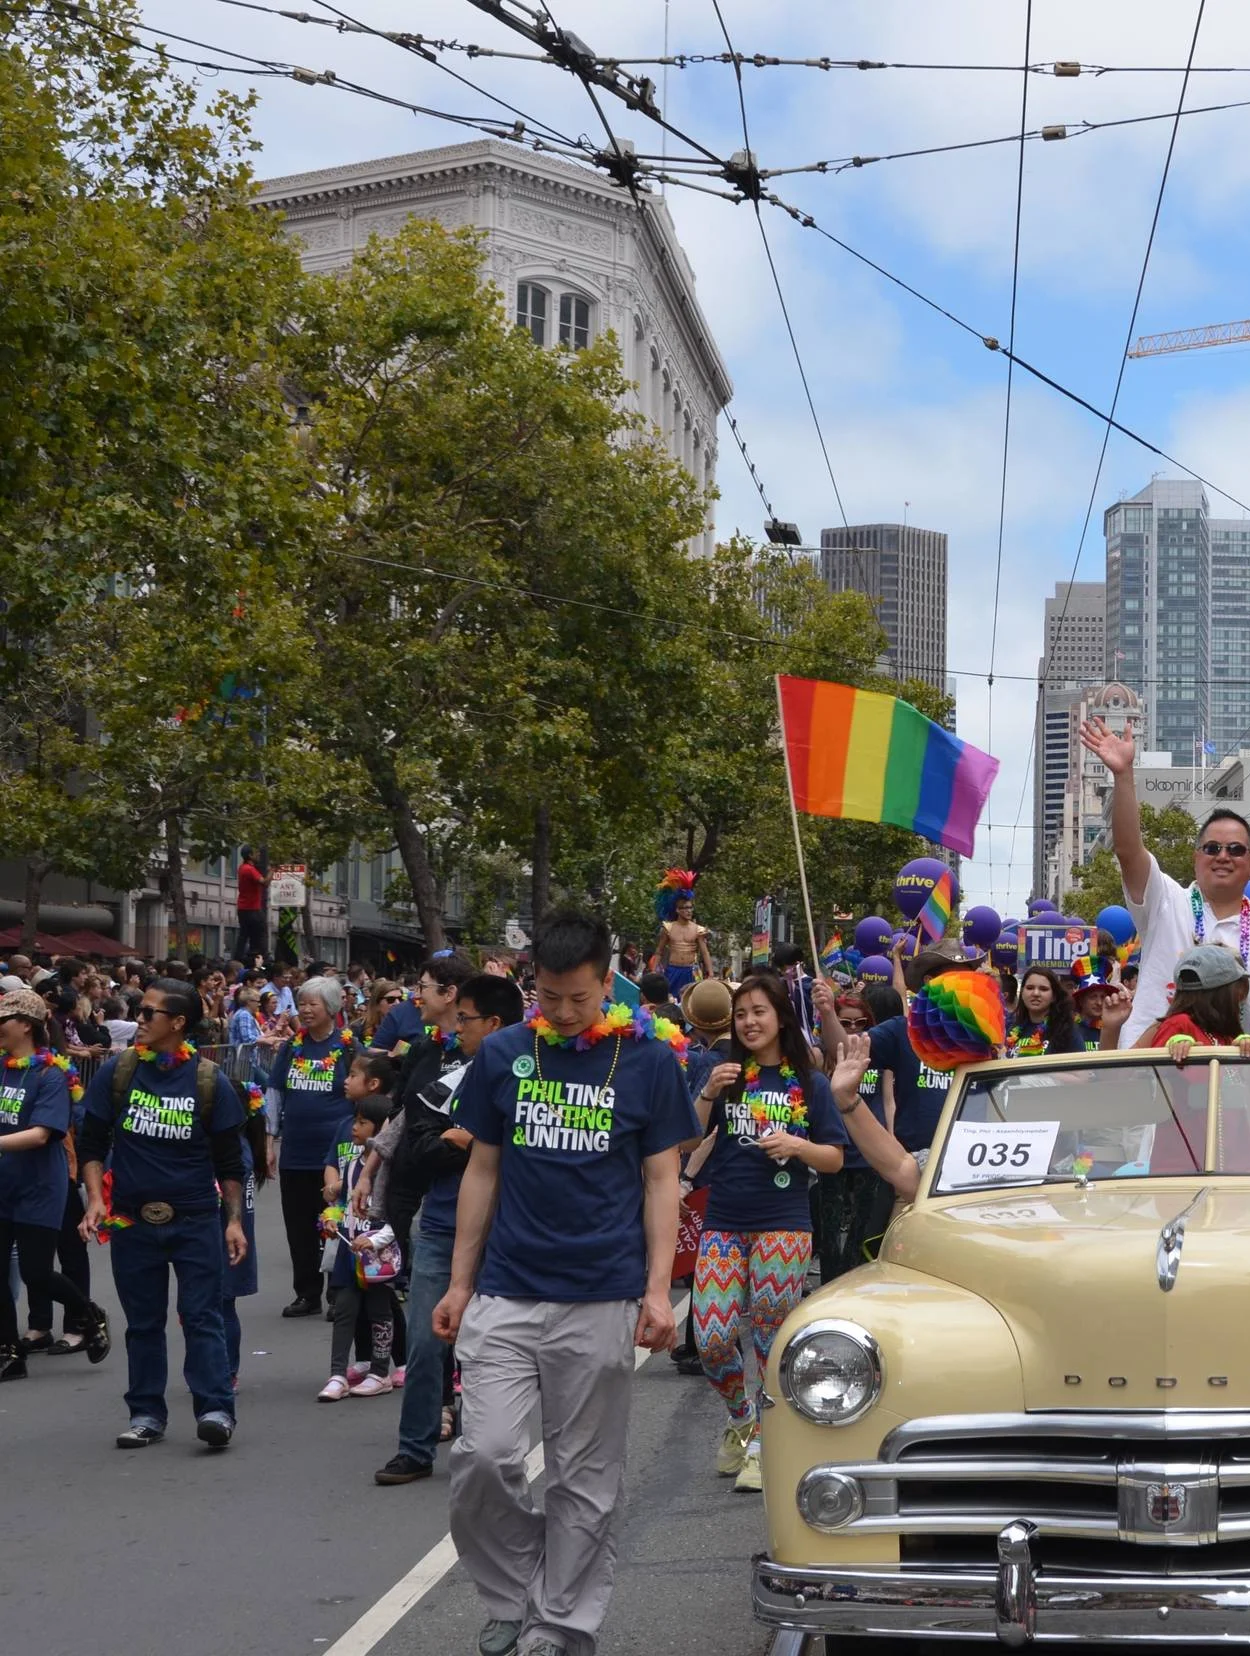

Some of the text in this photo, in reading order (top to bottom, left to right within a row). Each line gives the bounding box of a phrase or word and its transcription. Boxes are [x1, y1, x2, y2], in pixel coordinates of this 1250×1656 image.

[896, 874, 935, 888] thrive
[996, 942, 1017, 951] thrive
[862, 972, 888, 982] thrive
[129, 1089, 195, 1112] PHILTING
[517, 1079, 615, 1109] PHILTING
[128, 1104, 193, 1125] FIGHTING
[515, 1101, 613, 1131] FIGHTING
[122, 1117, 192, 1140] &UNITING
[512, 1125, 610, 1152] &UNITING
[967, 1142, 1033, 1167] 035
